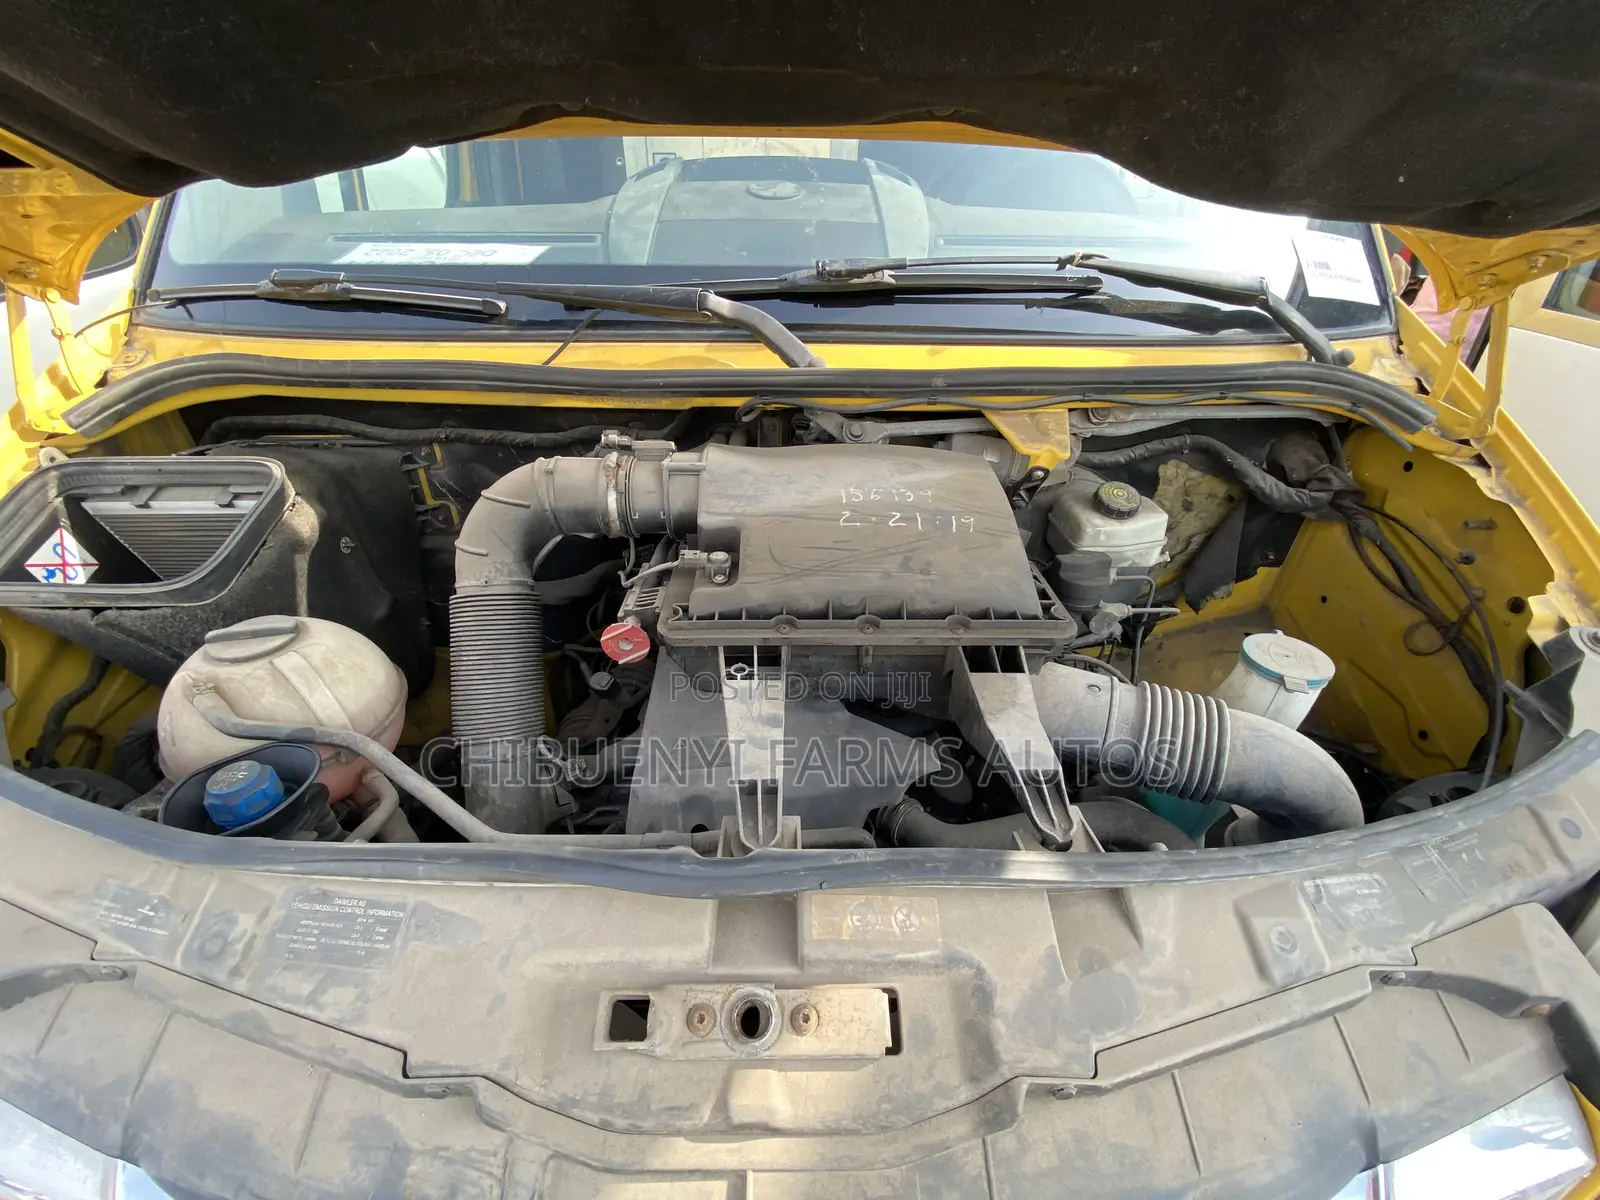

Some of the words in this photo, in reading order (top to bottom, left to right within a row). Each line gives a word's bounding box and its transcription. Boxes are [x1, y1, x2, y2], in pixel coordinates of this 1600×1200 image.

[333, 897, 357, 906] DAIMLER
[313, 903, 339, 912] EMISSION
[340, 906, 365, 915] CONTROL
[367, 908, 405, 918] INFORMATION
